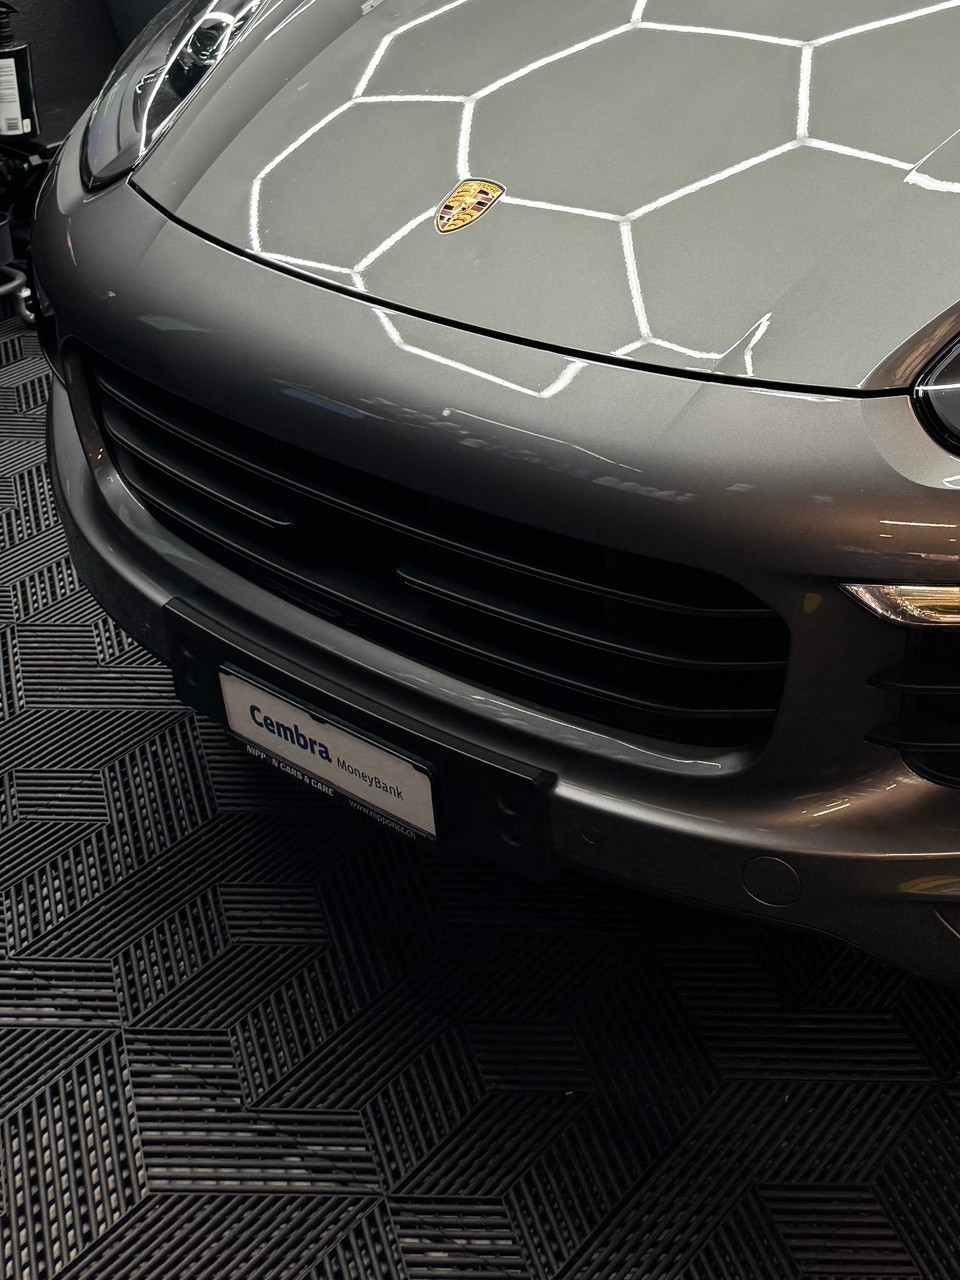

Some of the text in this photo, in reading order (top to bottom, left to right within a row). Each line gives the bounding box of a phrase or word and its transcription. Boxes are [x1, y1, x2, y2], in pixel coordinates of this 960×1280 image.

[249, 704, 404, 801] Cembra MoneyBank
[279, 761, 303, 780] CARS
[310, 778, 335, 797] CARE
